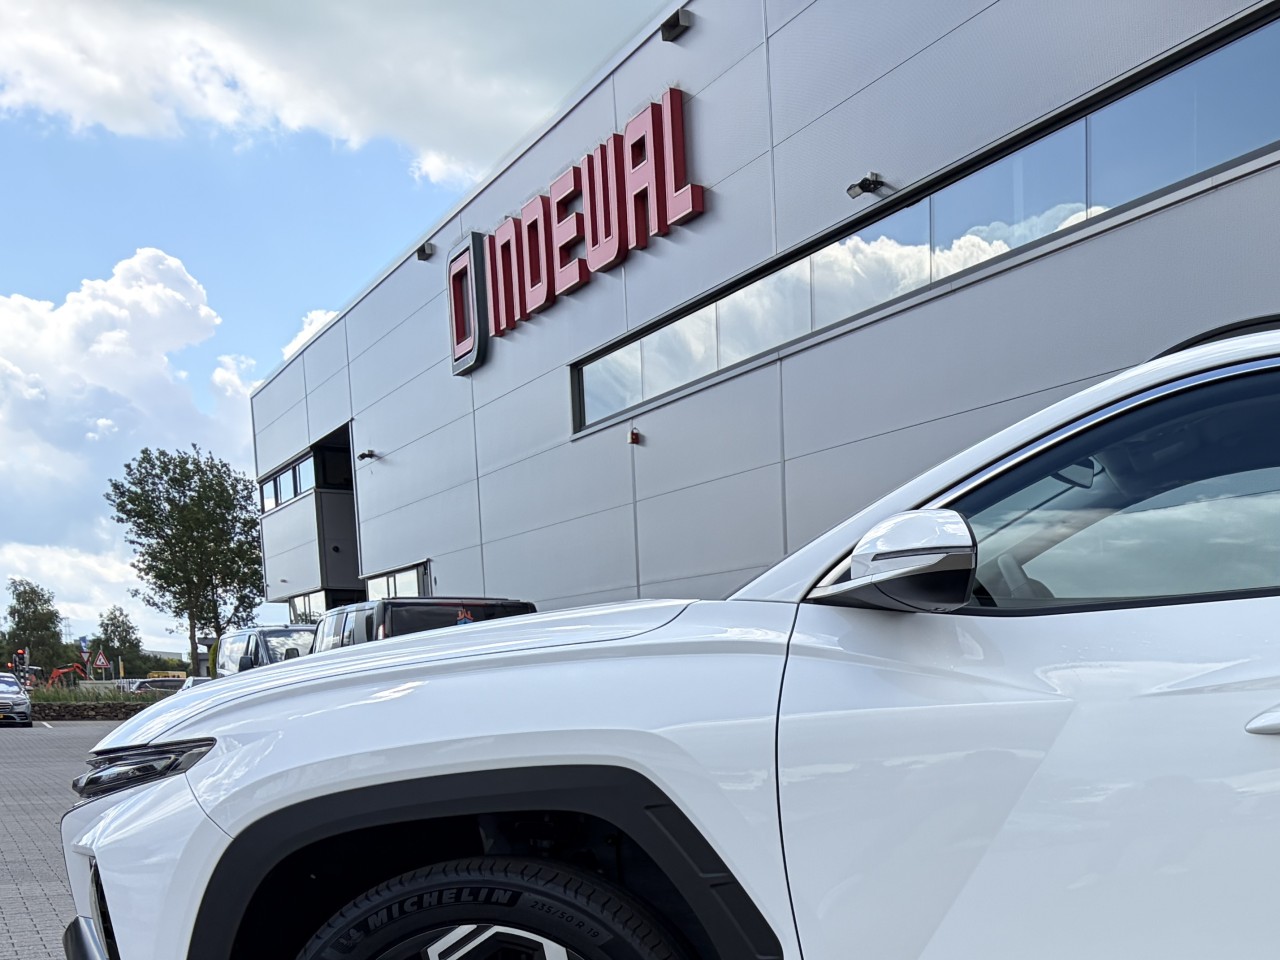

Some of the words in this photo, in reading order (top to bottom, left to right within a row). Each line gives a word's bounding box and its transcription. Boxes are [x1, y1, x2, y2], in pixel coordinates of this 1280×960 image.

[367, 887, 513, 930] MICHELIN
[529, 901, 574, 922] 235/50
[575, 919, 585, 929] R
